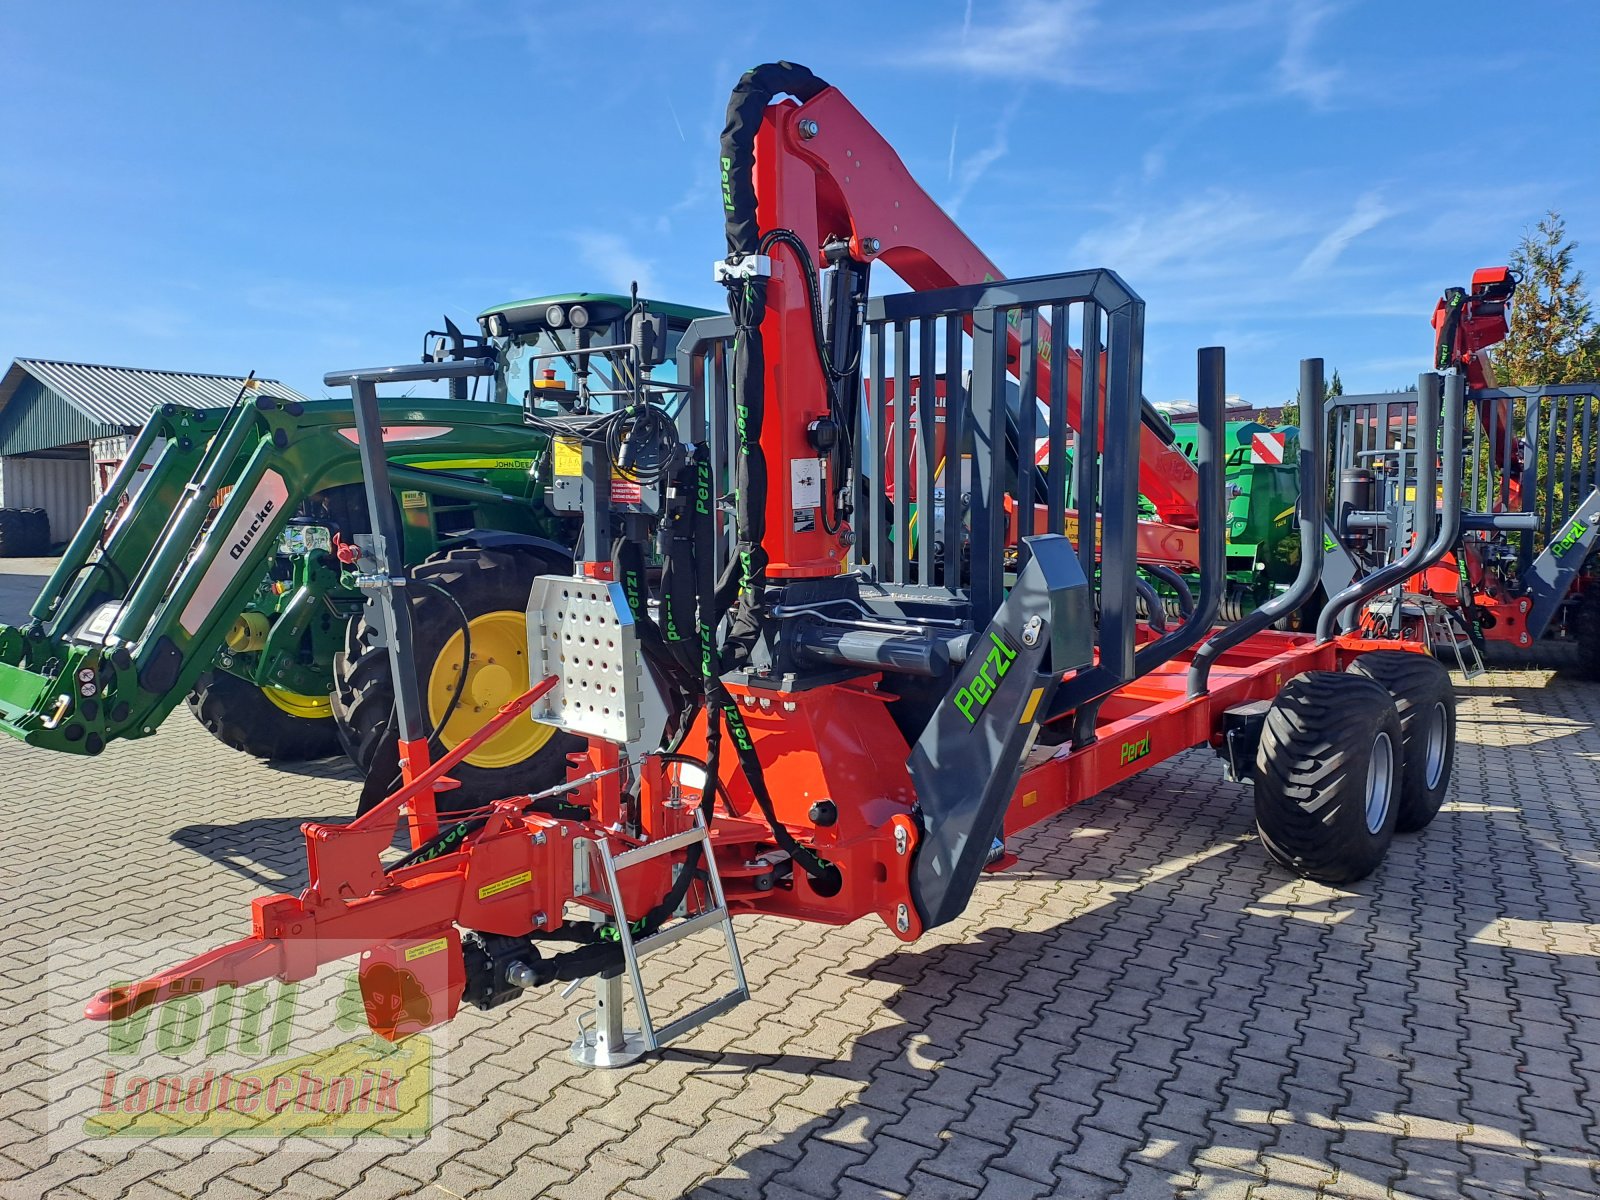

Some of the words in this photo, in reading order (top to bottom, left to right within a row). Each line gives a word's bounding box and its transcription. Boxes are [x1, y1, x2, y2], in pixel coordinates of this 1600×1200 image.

[721, 157, 735, 211] Perzl
[495, 460, 515, 468] JOHN
[696, 461, 709, 515] Perzl
[229, 499, 275, 561] Quicke
[1551, 521, 1588, 559] Perzl
[701, 622, 711, 677] Perzl
[953, 631, 1017, 724] Perzl
[724, 705, 753, 751] Perzl
[1120, 730, 1150, 767] Perzl
[600, 916, 647, 942] Pezl
